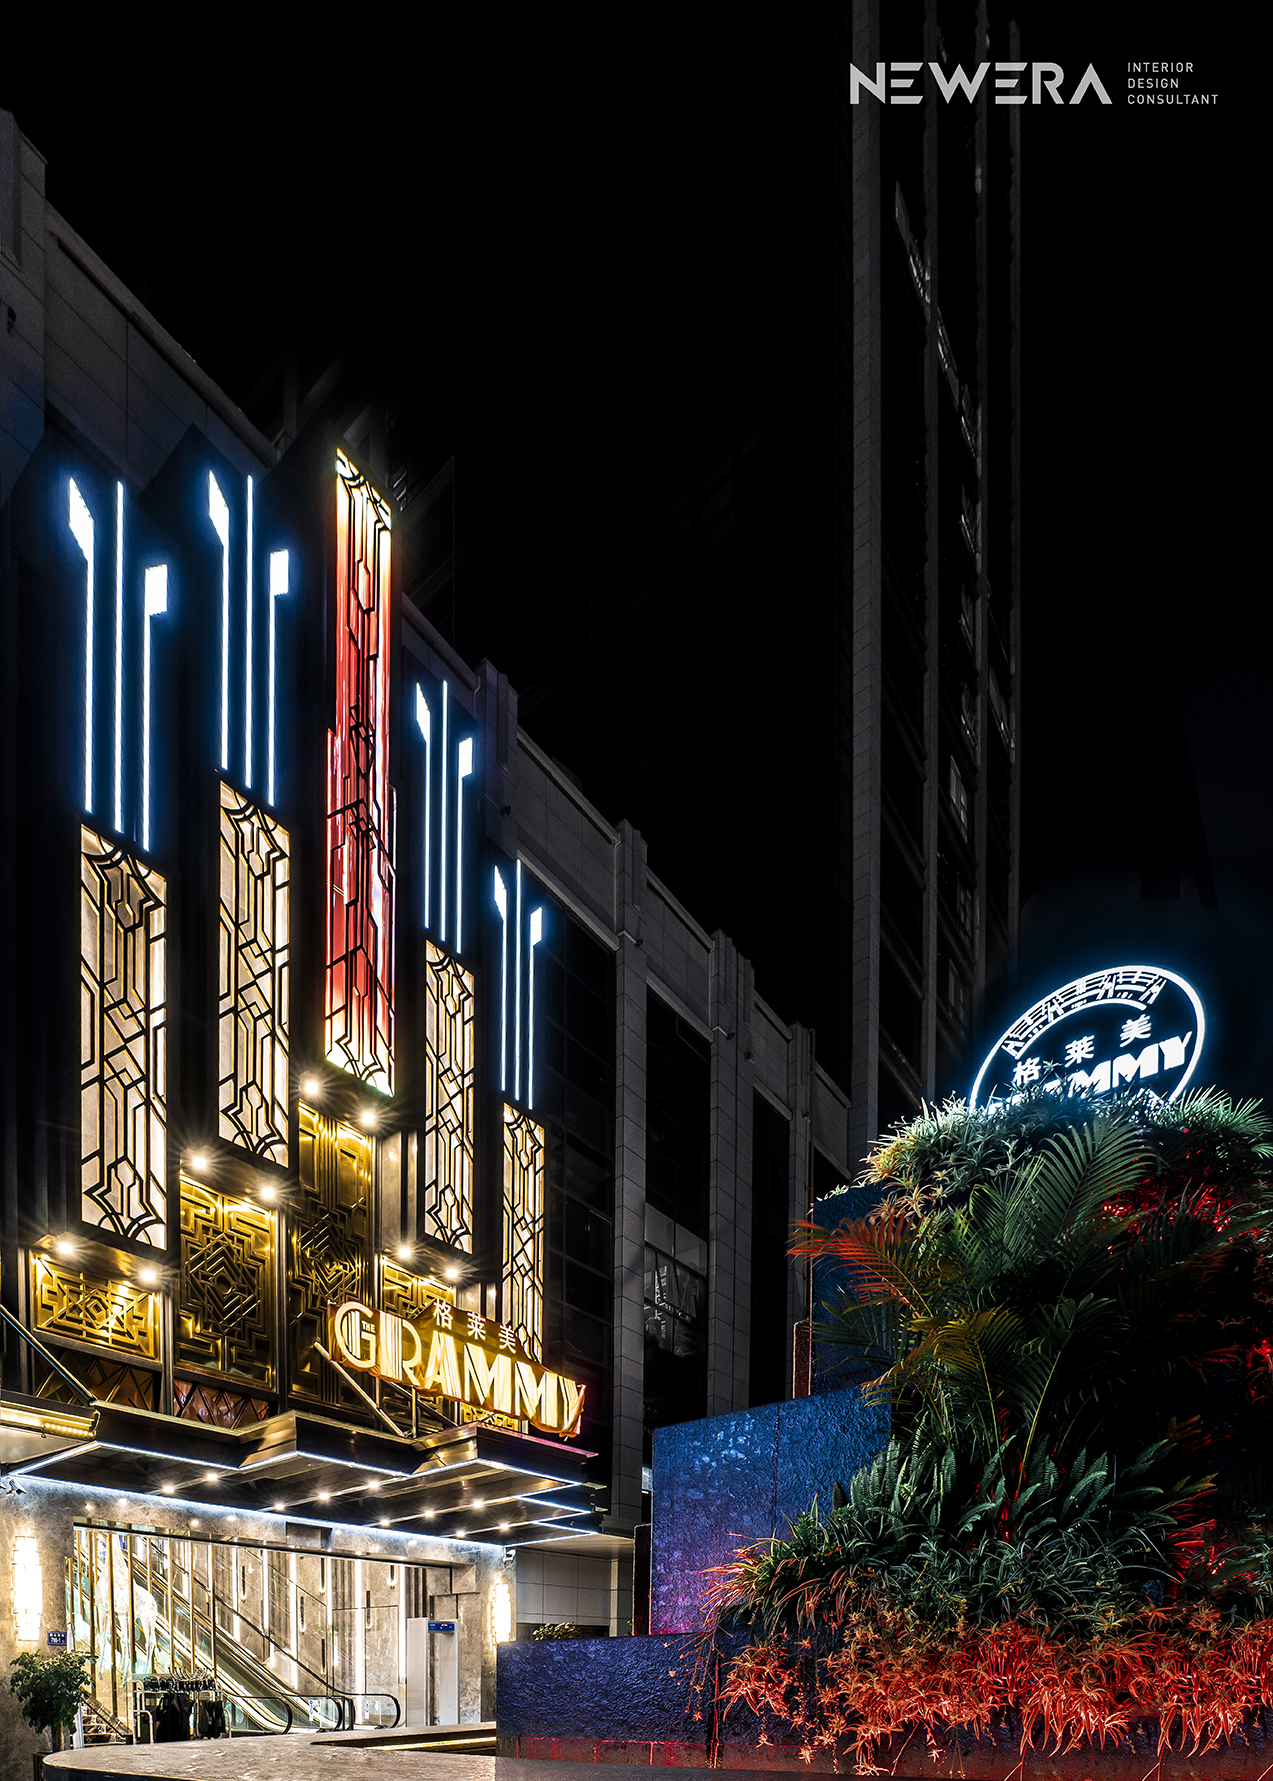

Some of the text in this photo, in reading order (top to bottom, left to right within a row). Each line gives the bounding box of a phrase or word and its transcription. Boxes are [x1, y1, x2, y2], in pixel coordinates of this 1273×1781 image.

[1012, 1013, 1152, 1087] 格莱美
[361, 1320, 376, 1333] THE
[433, 1298, 517, 1354] 格莱美
[334, 1301, 587, 1435] GRAMMY
